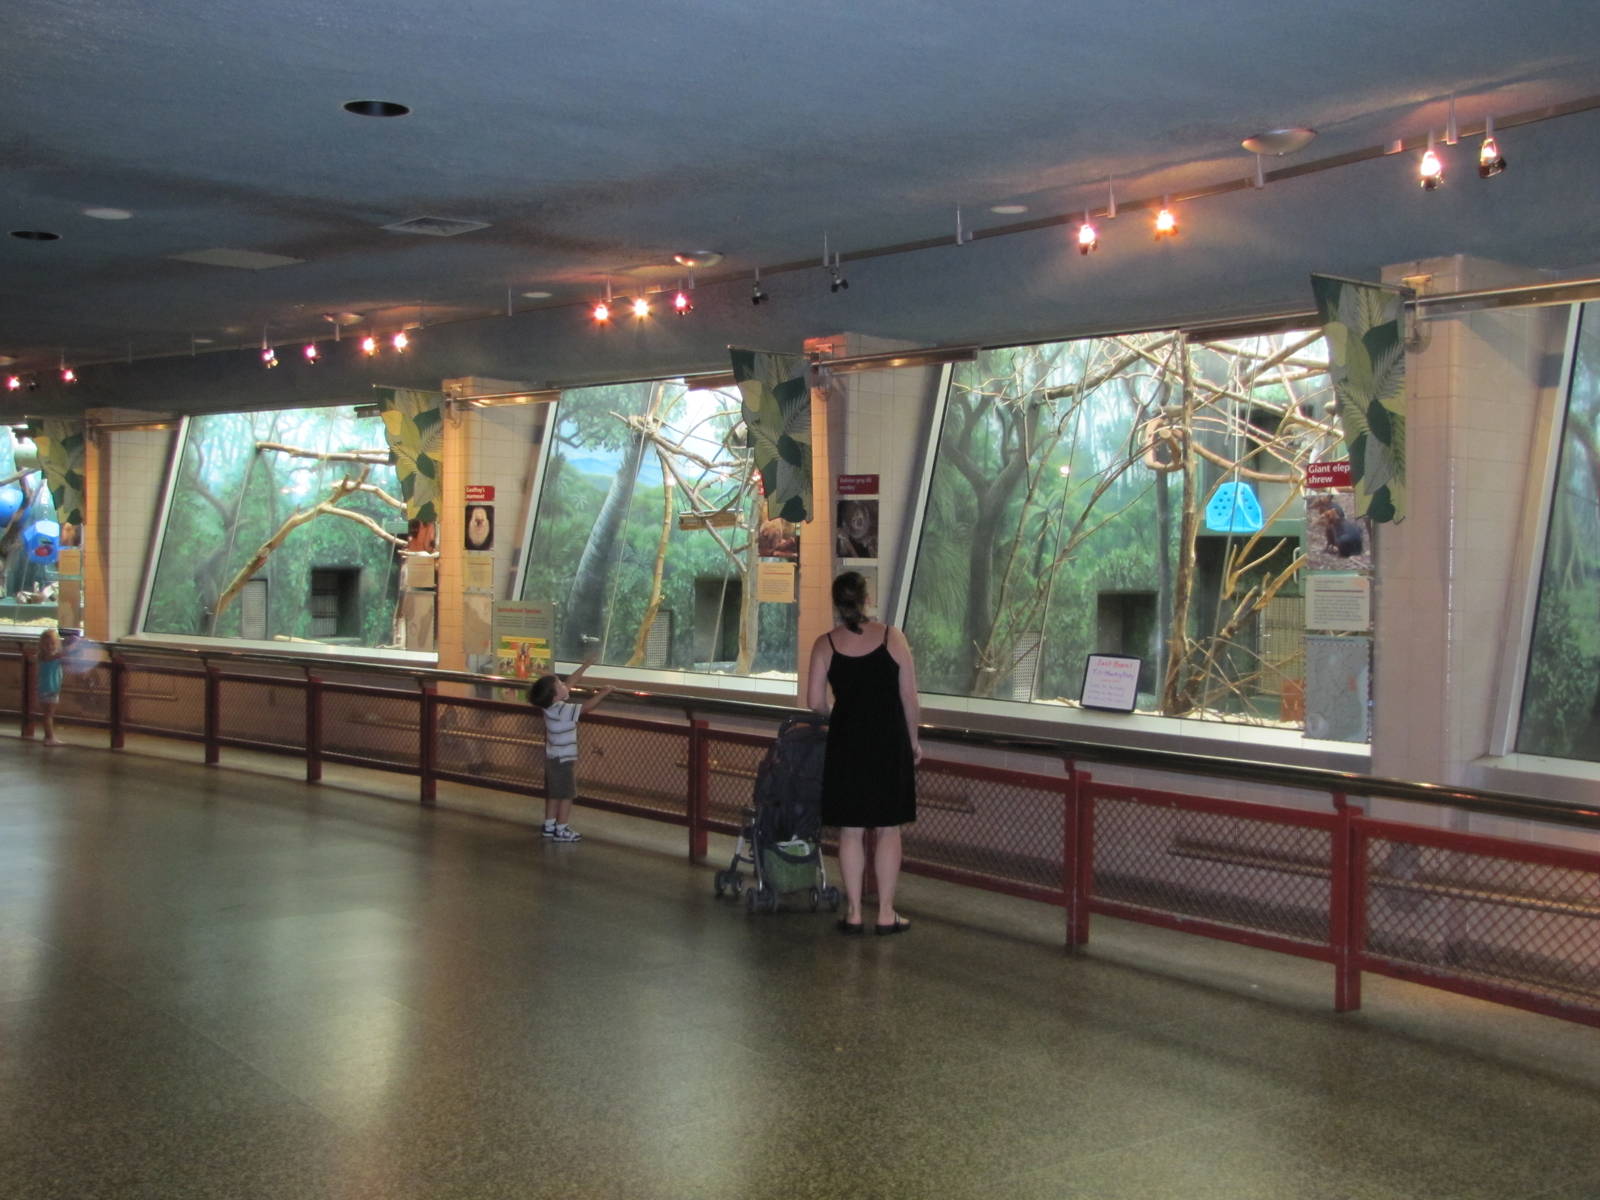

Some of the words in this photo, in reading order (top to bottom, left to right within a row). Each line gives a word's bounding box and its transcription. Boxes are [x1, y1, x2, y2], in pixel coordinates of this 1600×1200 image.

[1308, 464, 1331, 473] Giant
[1332, 463, 1351, 474] elep
[1308, 475, 1334, 483] shrew
